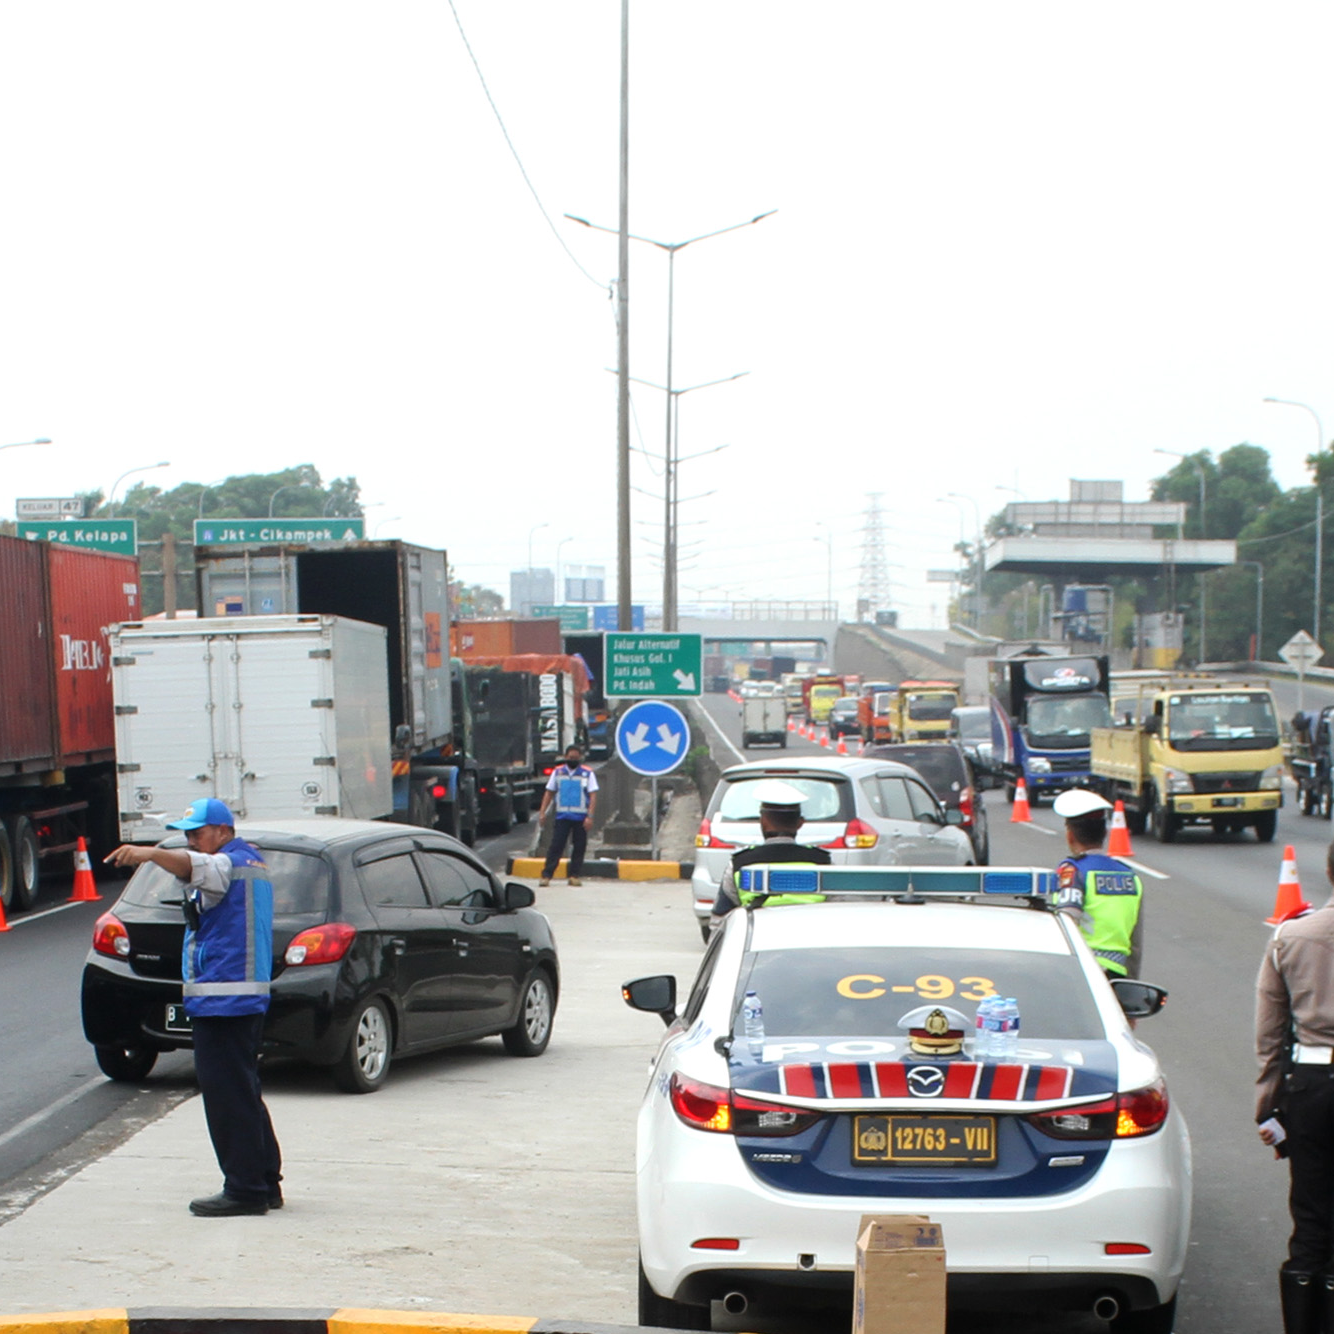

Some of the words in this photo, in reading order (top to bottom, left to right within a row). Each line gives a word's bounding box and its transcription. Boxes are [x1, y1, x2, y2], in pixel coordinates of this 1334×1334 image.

[47, 530, 70, 542] Pd.
[74, 530, 128, 543] Kelapa
[219, 528, 245, 541] Jkt
[259, 528, 332, 541] Cikampek
[836, 973, 999, 1001] C-93
[895, 1127, 946, 1151] 12763
[964, 1127, 988, 1151] VII
